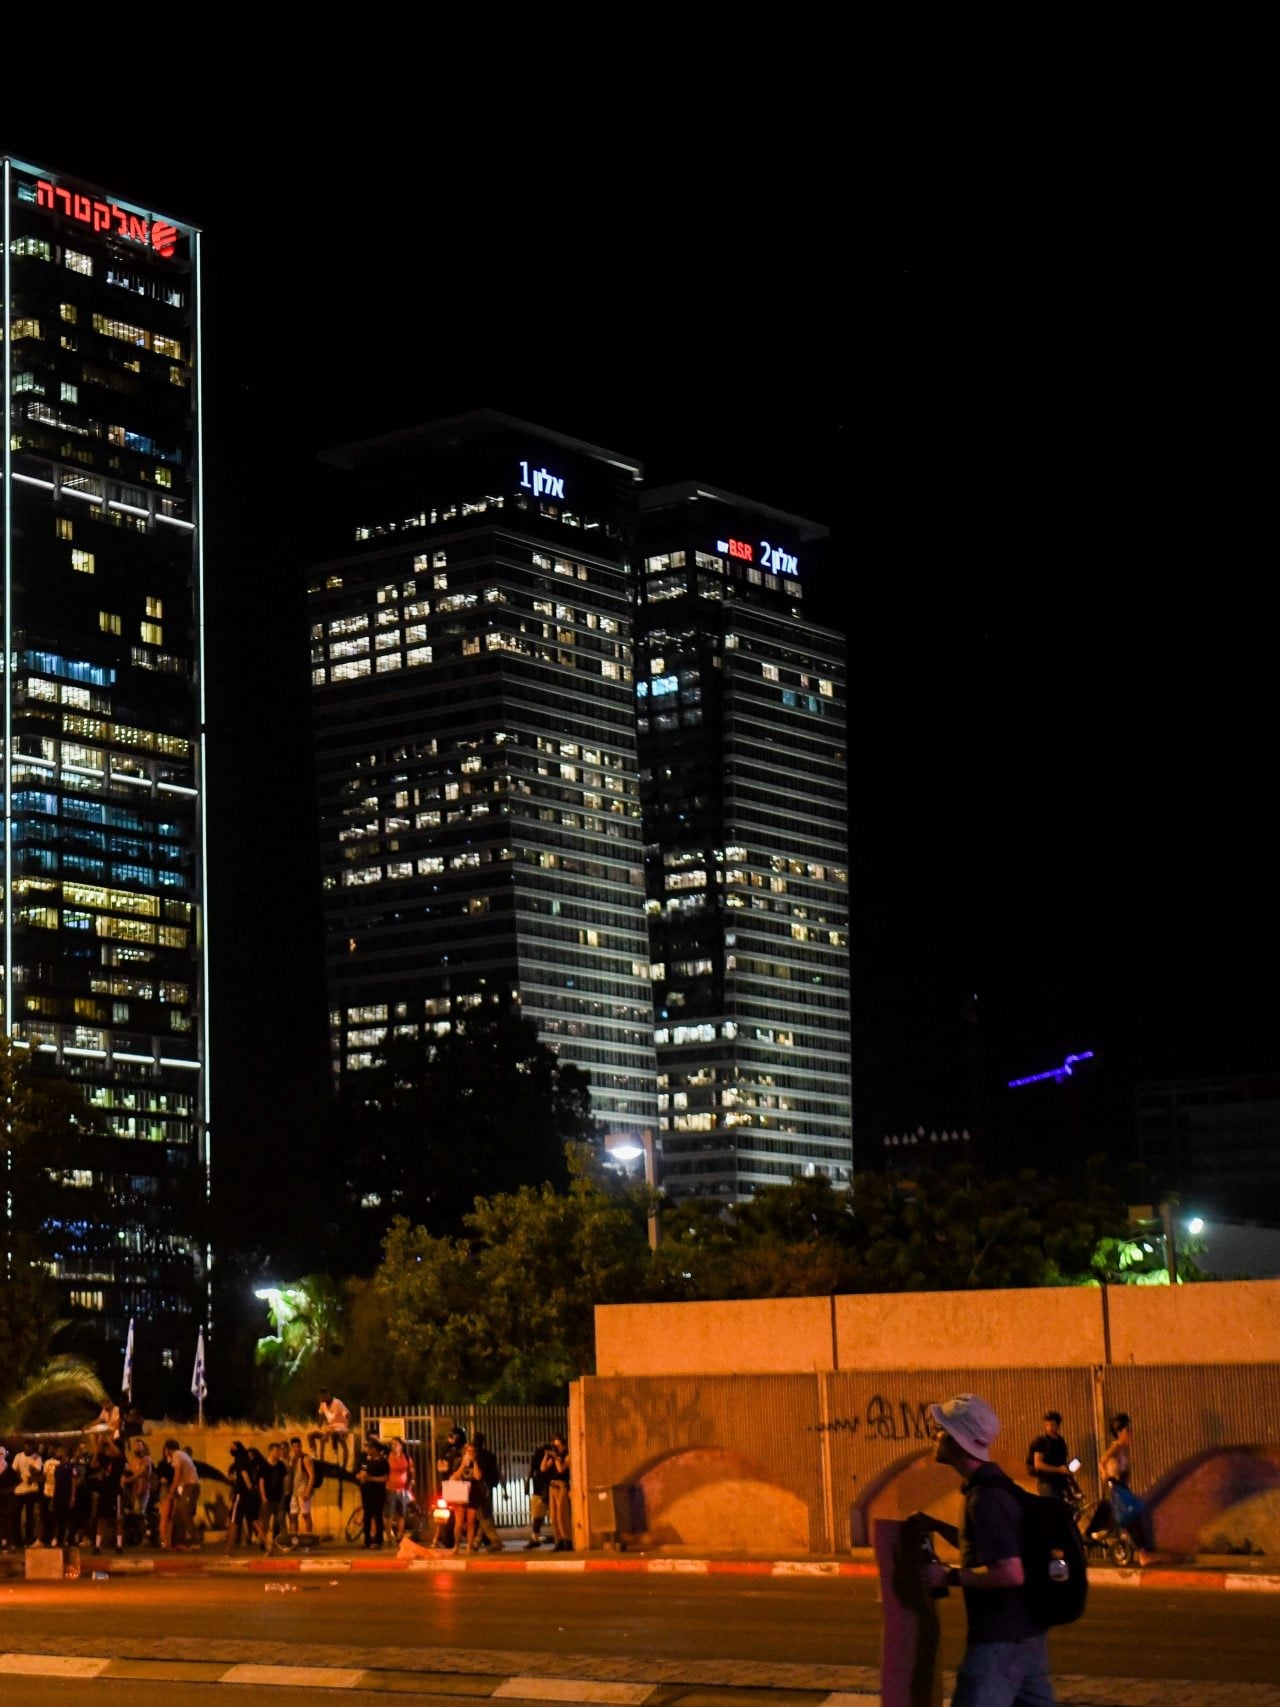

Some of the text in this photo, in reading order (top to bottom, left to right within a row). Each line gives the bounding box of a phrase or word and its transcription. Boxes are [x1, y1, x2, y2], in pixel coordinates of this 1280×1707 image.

[36, 180, 149, 242] אלקטרה
[520, 461, 564, 499] אלון 1
[760, 541, 771, 567] 2
[771, 547, 798, 575] אלון
